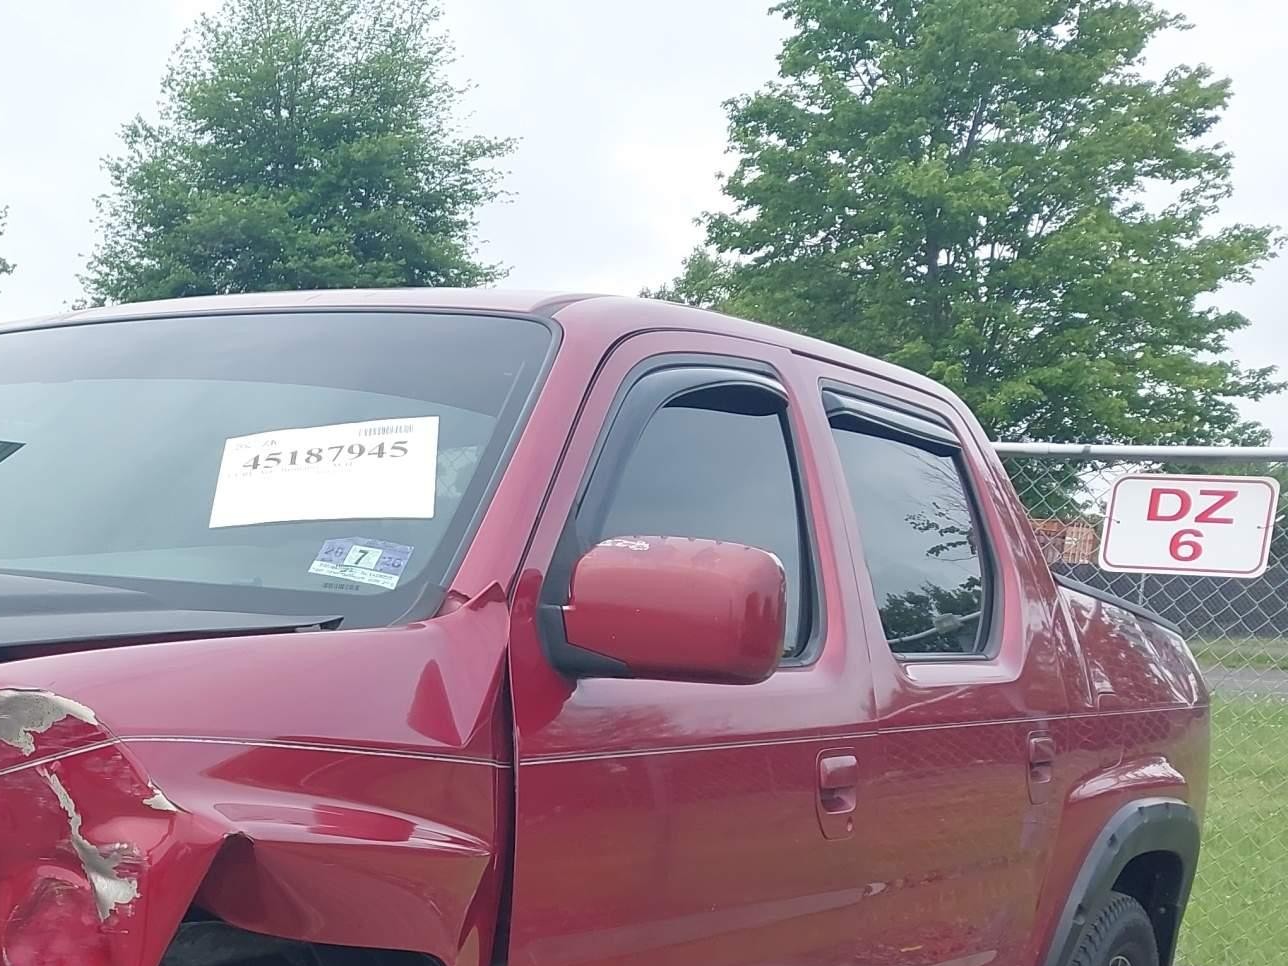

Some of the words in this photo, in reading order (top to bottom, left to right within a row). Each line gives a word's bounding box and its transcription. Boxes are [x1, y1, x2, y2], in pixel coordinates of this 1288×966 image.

[243, 441, 409, 469] 45187945
[1146, 487, 1239, 524] DZ
[355, 549, 369, 565] 7
[1168, 528, 1205, 562] 6
